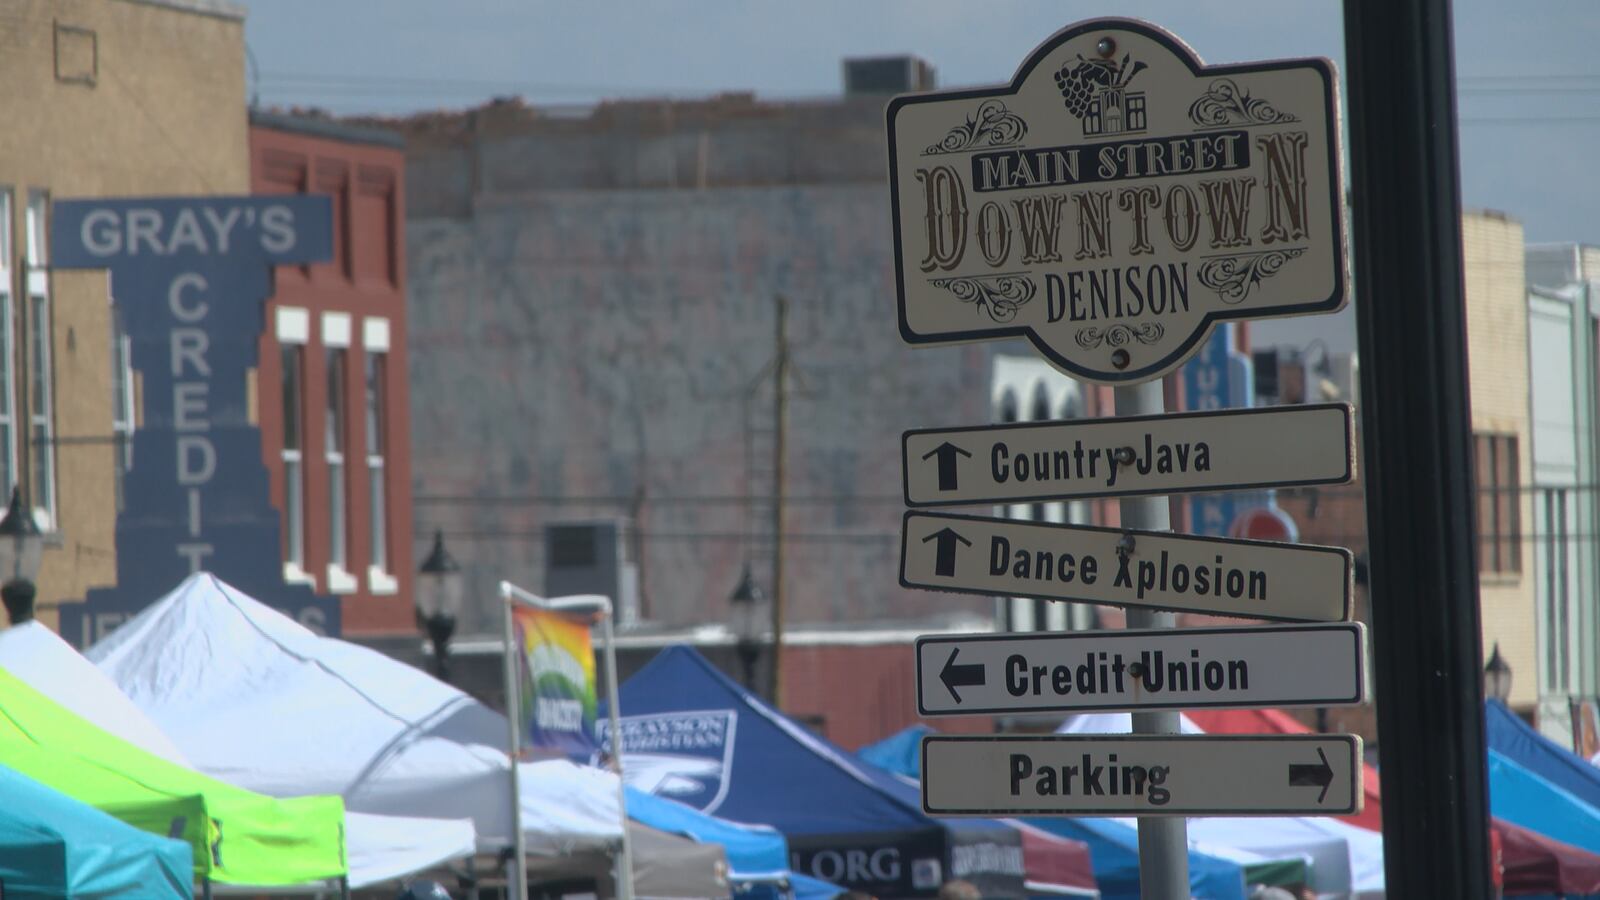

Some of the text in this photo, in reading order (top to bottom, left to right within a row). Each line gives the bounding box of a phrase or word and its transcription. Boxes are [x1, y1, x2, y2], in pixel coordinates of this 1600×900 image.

[979, 134, 1241, 189] MAIN STREET
[914, 131, 1309, 273] DOWNTOWN
[81, 205, 296, 256] GRAY'S
[1045, 262, 1191, 323] DENISON
[168, 273, 217, 574] CREDIT
[990, 433, 1211, 487] Country Java
[989, 535, 1267, 601] Dance Xplosion
[1005, 649, 1249, 697] Credit Union
[1009, 753, 1171, 806] Parking
